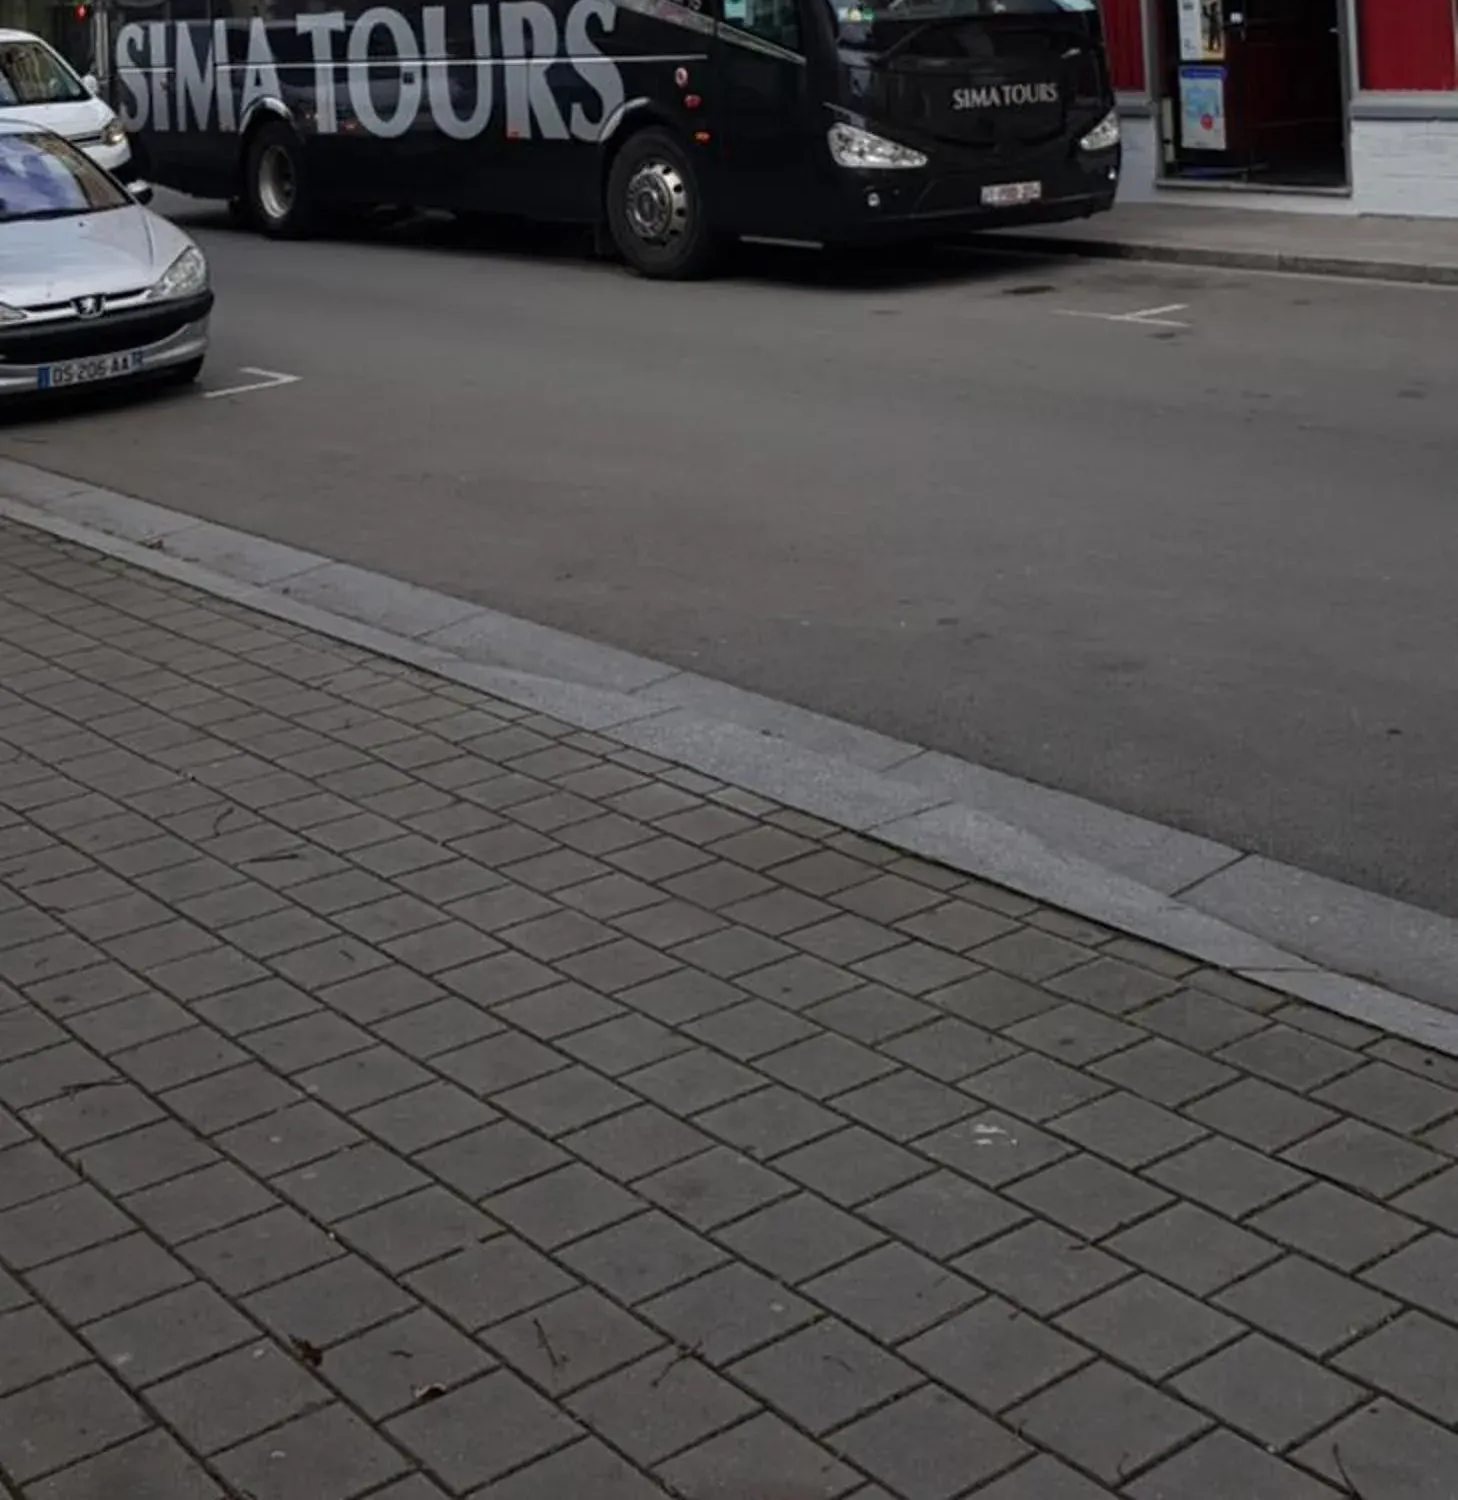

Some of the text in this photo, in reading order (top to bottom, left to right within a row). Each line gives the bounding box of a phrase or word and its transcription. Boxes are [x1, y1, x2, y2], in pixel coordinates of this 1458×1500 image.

[115, 16, 287, 134] SIMA
[952, 82, 1060, 111] SIMA TOURS
